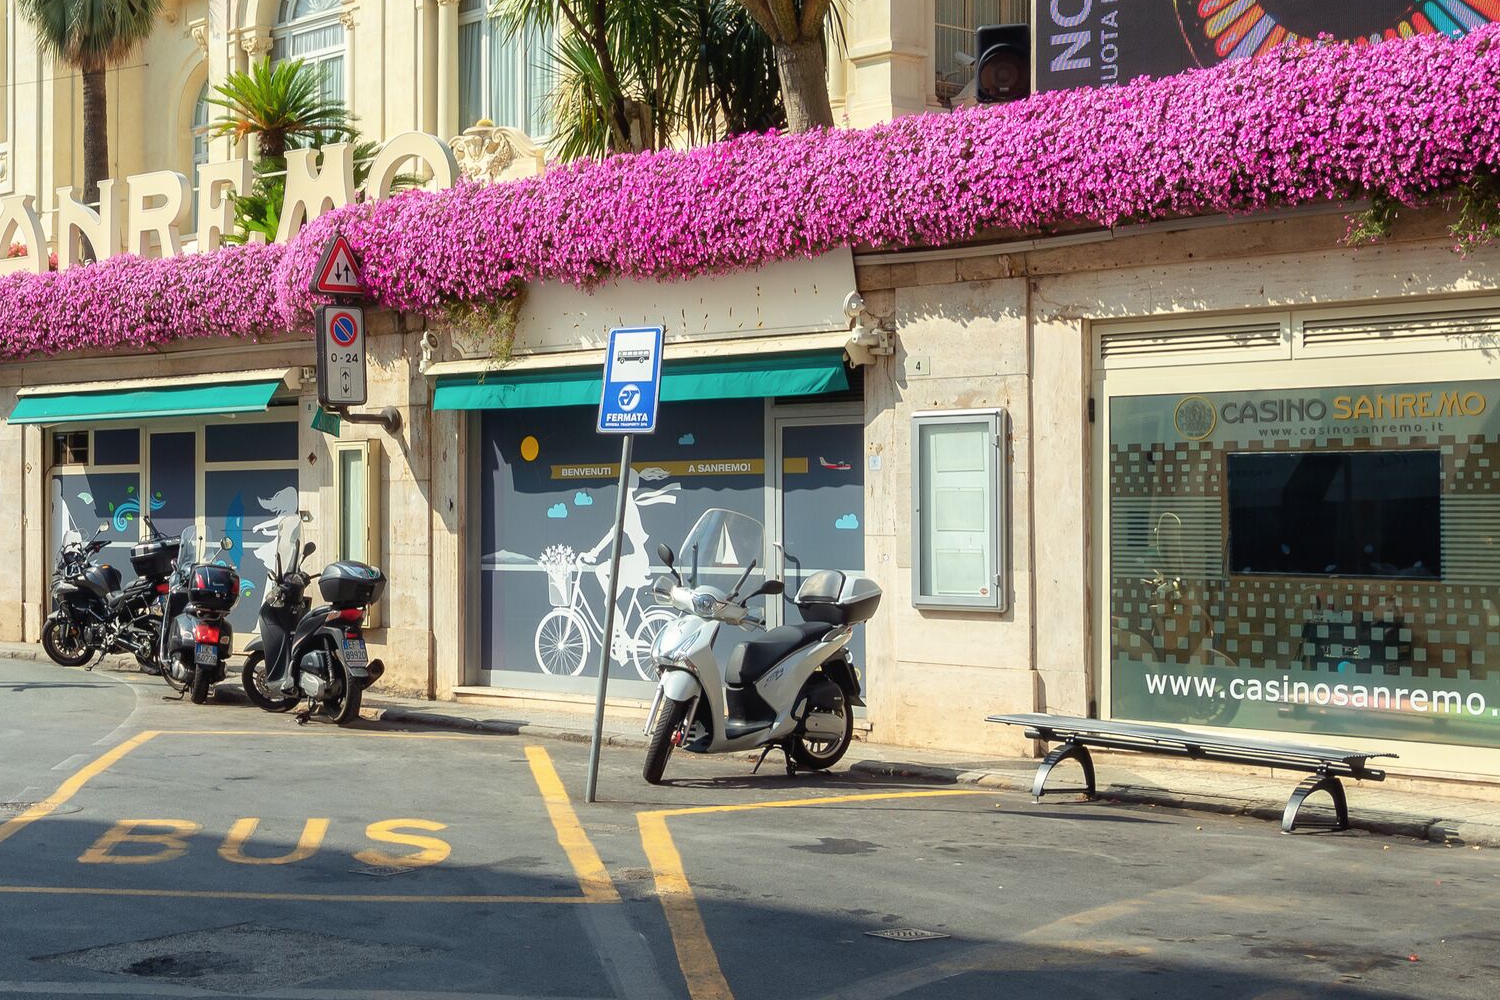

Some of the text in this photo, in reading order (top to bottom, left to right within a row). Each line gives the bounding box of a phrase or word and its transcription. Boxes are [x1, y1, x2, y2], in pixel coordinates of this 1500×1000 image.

[915, 361, 921, 371] 4
[1220, 391, 1487, 425] CASINO SANREMO
[606, 412, 649, 422] FERMATA
[1258, 421, 1445, 437] www.casinosanremo.it
[561, 462, 752, 477] BENVENUTI A SANREMO!
[345, 650, 367, 660] 89920
[76, 817, 453, 868] BUS
